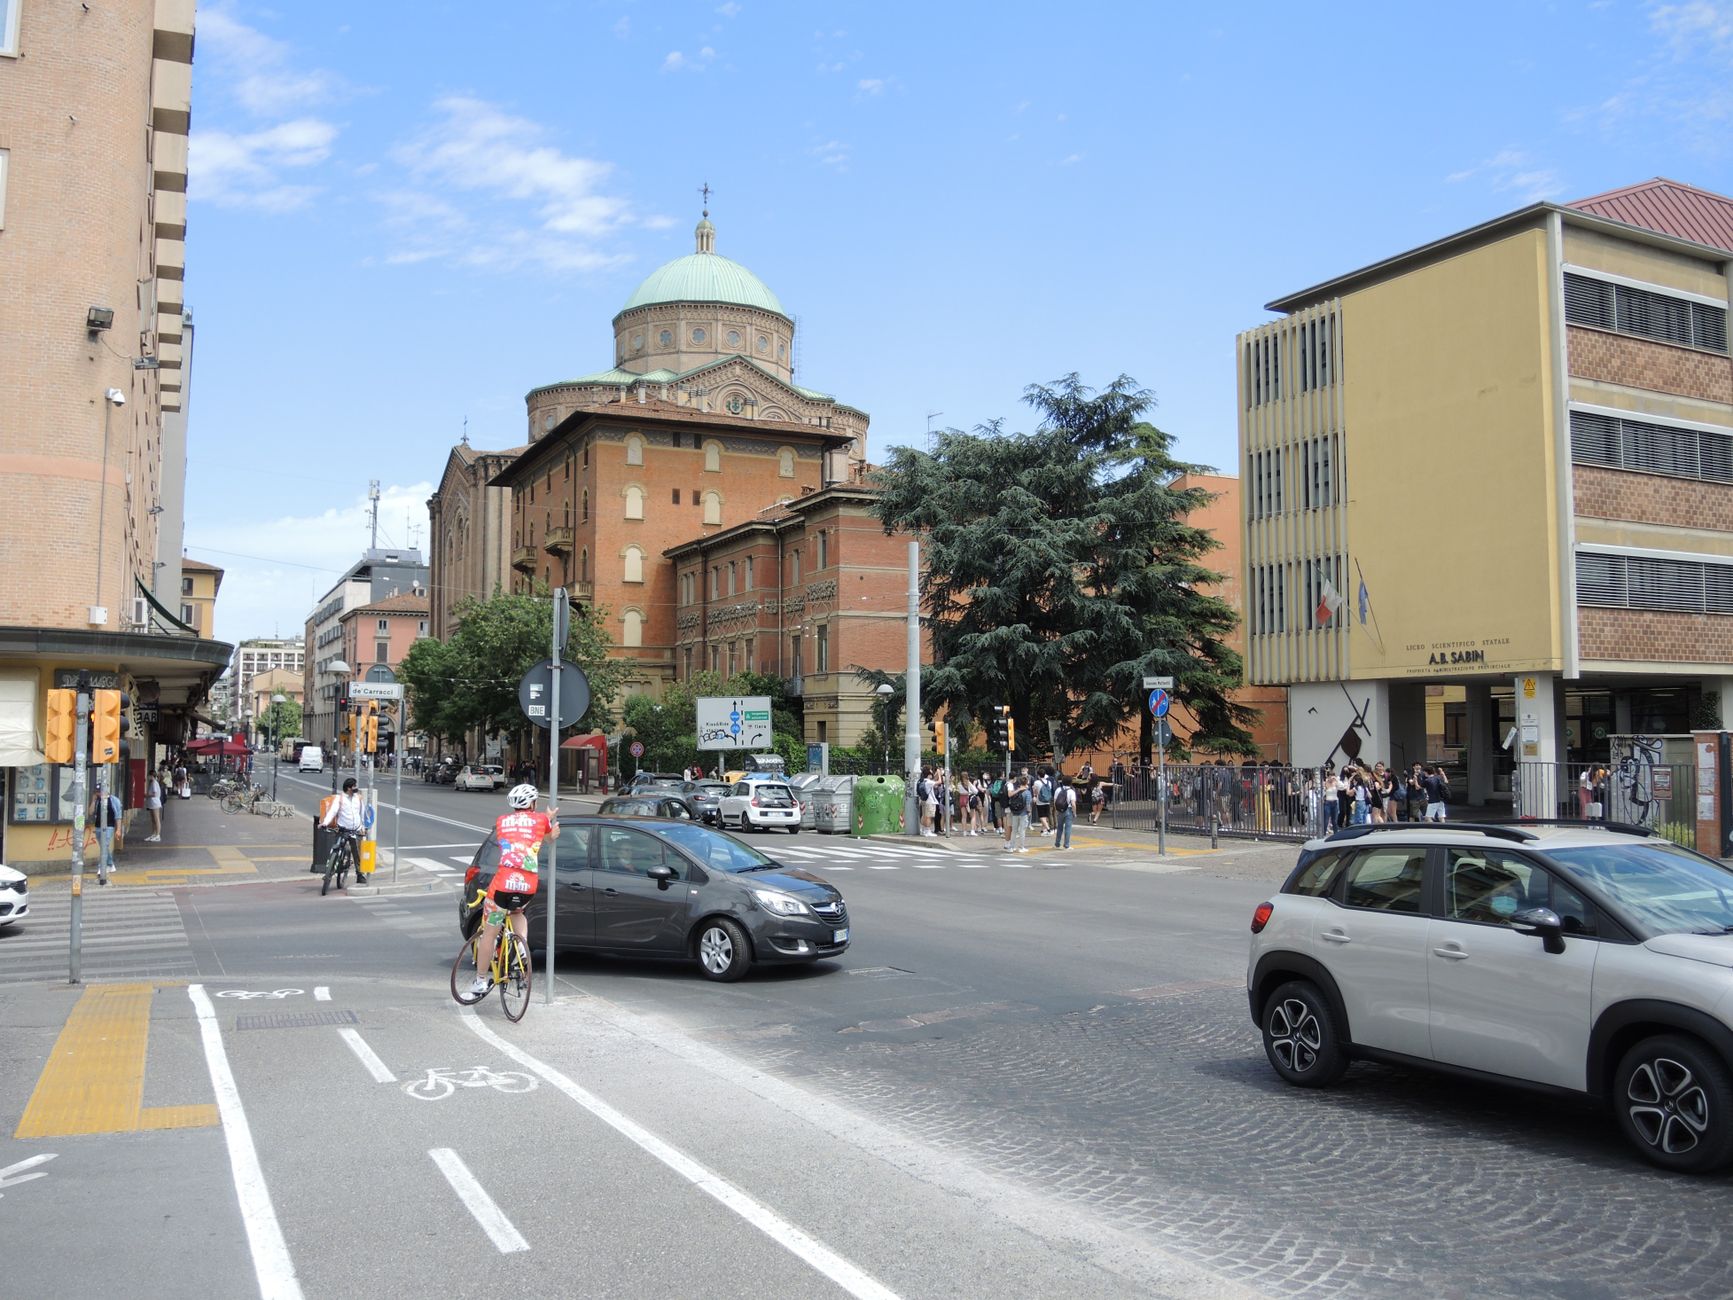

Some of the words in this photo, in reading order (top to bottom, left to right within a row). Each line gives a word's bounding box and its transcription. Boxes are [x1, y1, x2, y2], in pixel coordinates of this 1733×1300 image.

[1432, 640, 1475, 649] SCIENTIFICO
[1429, 652, 1448, 665] A.B.
[1451, 650, 1484, 664] SABIN
[530, 706, 543, 715] BNE
